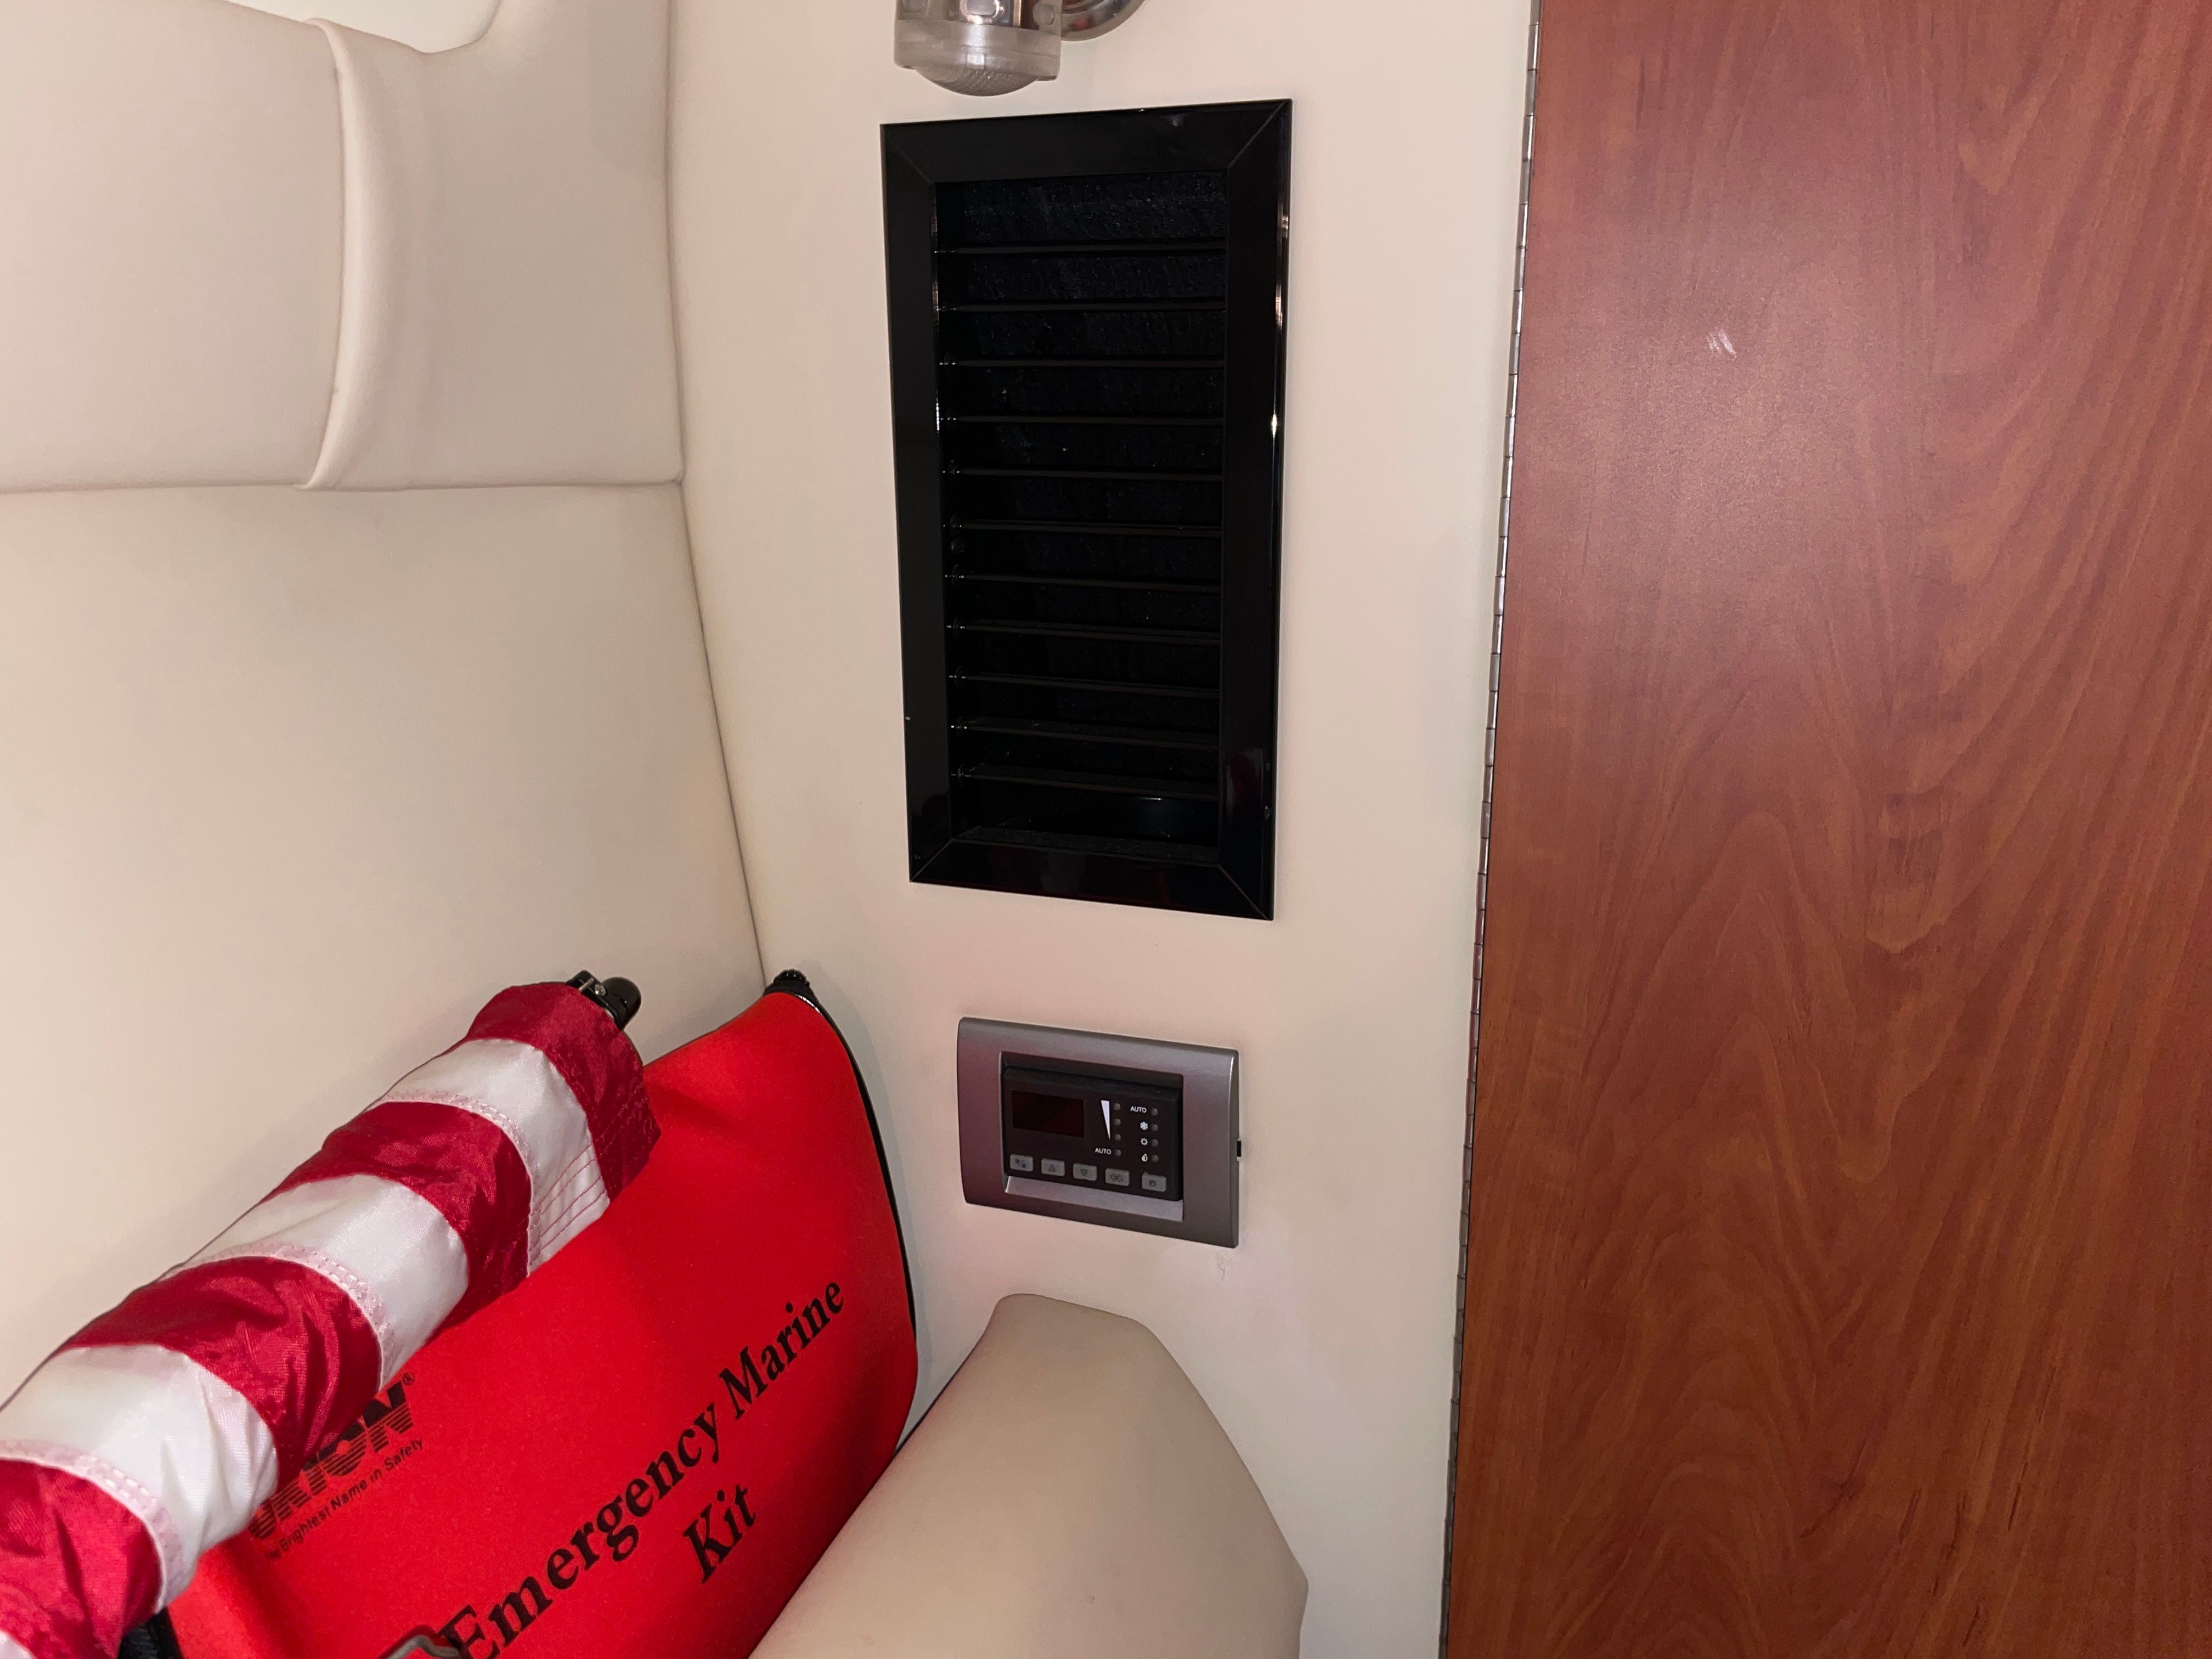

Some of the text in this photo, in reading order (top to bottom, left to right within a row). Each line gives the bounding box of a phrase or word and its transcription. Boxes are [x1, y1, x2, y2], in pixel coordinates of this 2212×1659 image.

[1130, 1105, 1147, 1114] AUTO
[331, 1479, 367, 1510] Name
[370, 1468, 382, 1483] in
[384, 1438, 423, 1471] Safety
[437, 1281, 845, 1659] Emergency Marine
[682, 1483, 758, 1584] Kit
